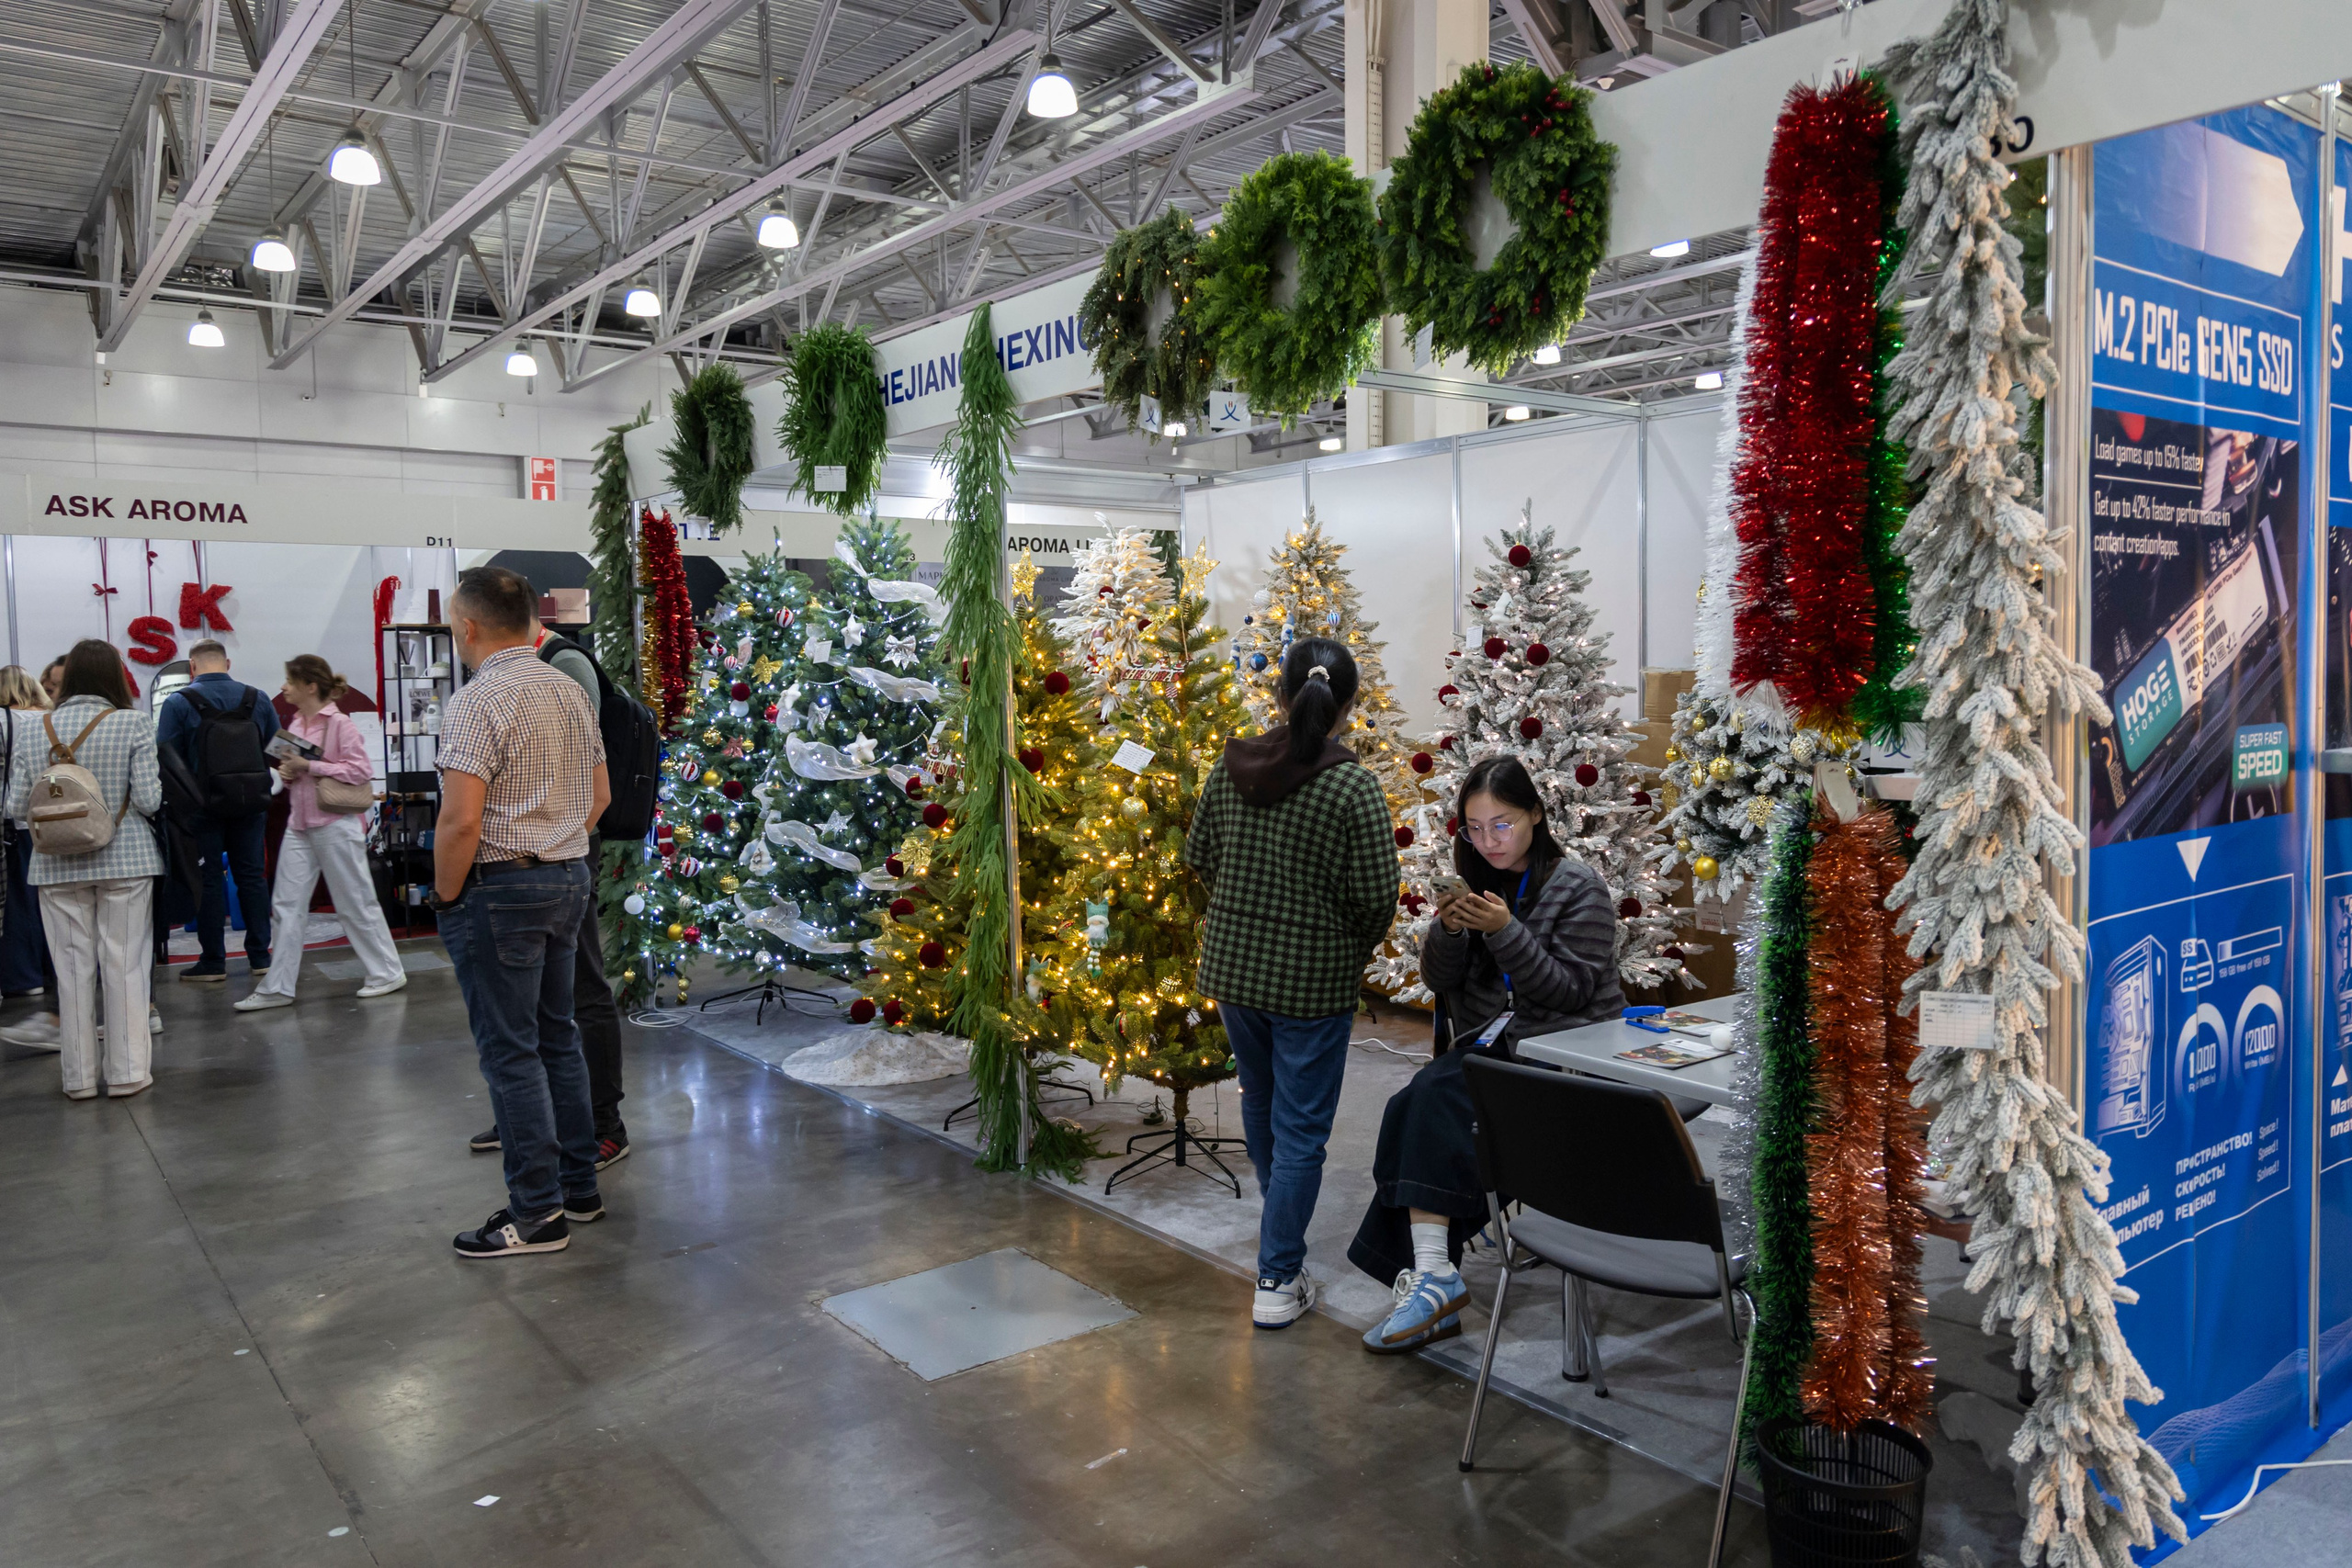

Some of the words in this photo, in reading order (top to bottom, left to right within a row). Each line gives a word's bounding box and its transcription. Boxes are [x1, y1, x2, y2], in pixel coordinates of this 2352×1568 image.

[2094, 288, 2136, 362] M.2
[2141, 300, 2190, 375] PCIe
[2197, 316, 2252, 387] GEN5
[2258, 331, 2292, 396] SSD
[876, 353, 965, 407] HEJIAN
[2095, 434, 2115, 460] Load
[2116, 445, 2143, 468] games
[2143, 449, 2154, 469] up
[2154, 446, 2164, 468] to
[2165, 445, 2180, 469] 15%
[44, 494, 115, 518] ASK
[127, 499, 248, 524] AROMA
[2095, 491, 2109, 516] Get
[2110, 501, 2120, 522] up
[2122, 497, 2131, 518] to
[2132, 494, 2151, 520] 42%
[2152, 496, 2175, 522] faster
[2222, 507, 2231, 526] in
[426, 536, 452, 547] D11
[1008, 536, 1069, 554] AROMA
[2094, 530, 2126, 554] content
[2127, 534, 2159, 555] creation
[409, 690, 432, 698] LOEWE
[2122, 659, 2171, 731] HOGE
[2128, 689, 2174, 745] STORAGE
[2239, 732, 2263, 749] SUPER
[2265, 730, 2283, 745] FAST
[2238, 750, 2282, 779] SPEED
[2245, 1023, 2276, 1056] 12000
[2188, 1043, 2216, 1078] 1000
[2096, 1184, 2150, 1224] лавный
[2116, 1209, 2165, 1245] пьютер
